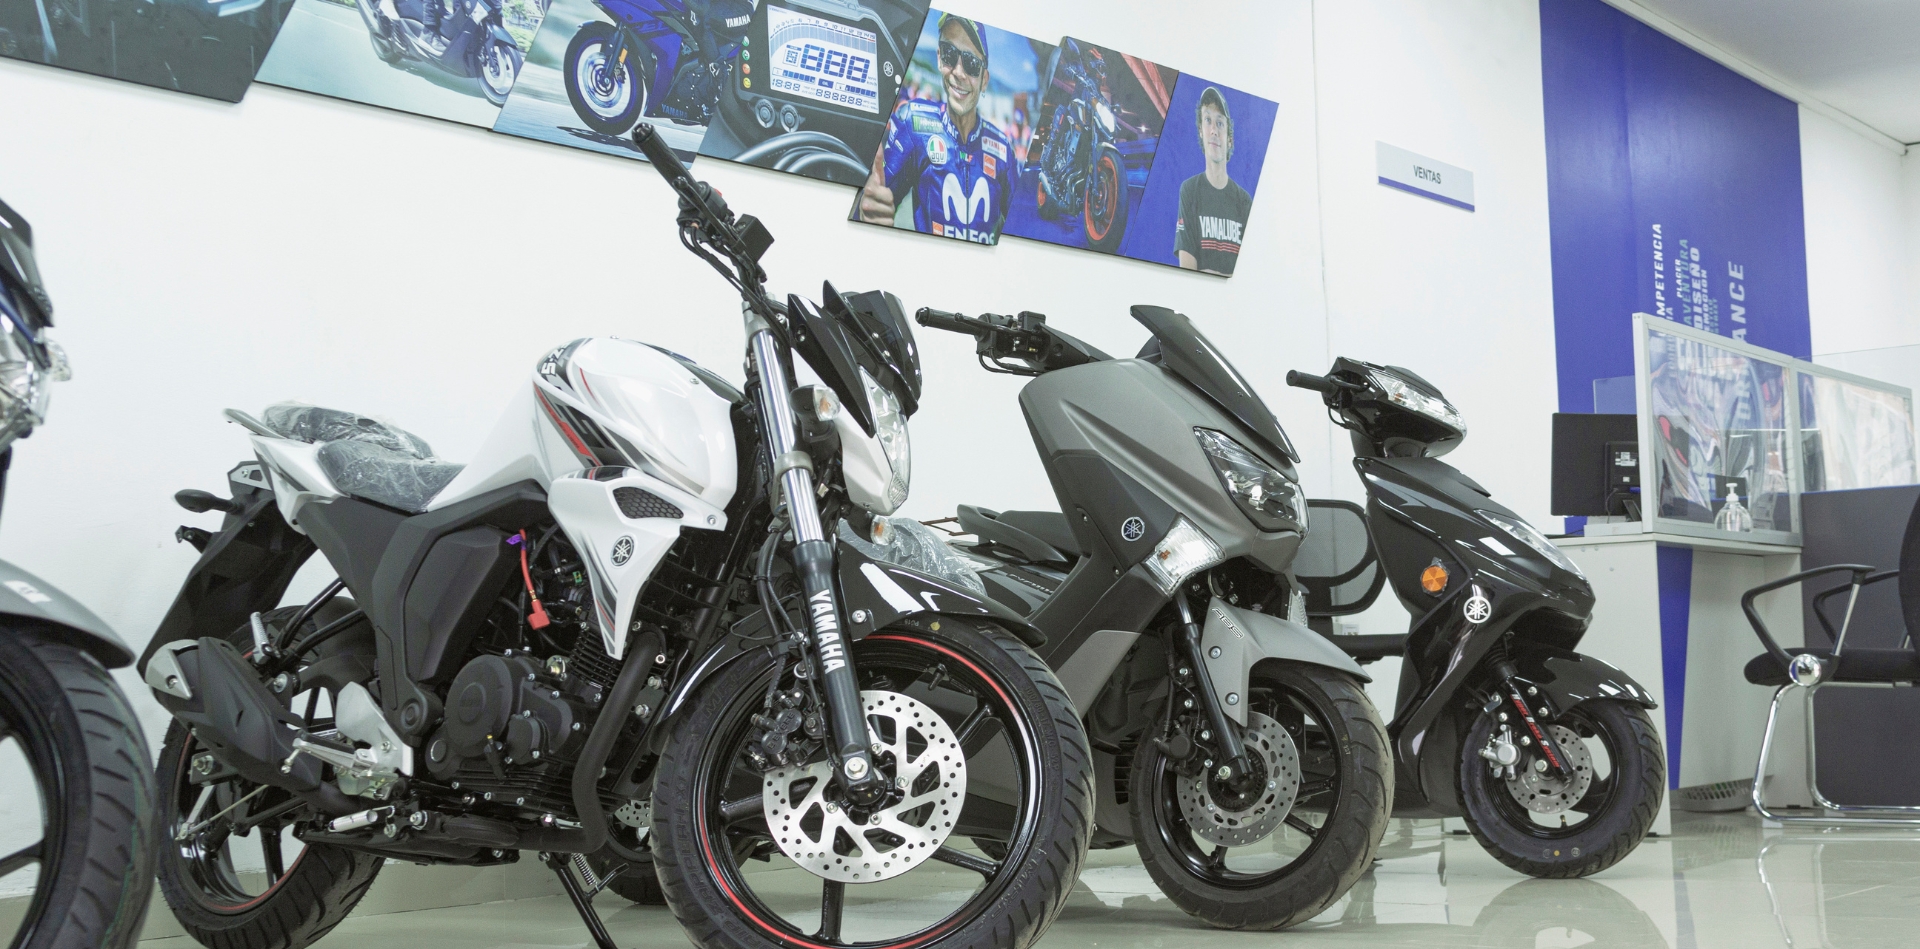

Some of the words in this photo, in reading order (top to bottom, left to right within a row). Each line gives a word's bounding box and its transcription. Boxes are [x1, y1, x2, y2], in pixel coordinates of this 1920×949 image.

[725, 14, 751, 28] YAMAHA
[800, 43, 870, 84] 888
[661, 103, 687, 120] YAMAHA
[1413, 164, 1442, 185] VENTAS
[1199, 215, 1242, 245] YAMALUBE
[1652, 223, 1666, 318] MPETENCIA
[1675, 258, 1683, 298] PLACER
[1679, 239, 1692, 326] AVENTURA
[810, 589, 845, 674] YAMAHA
